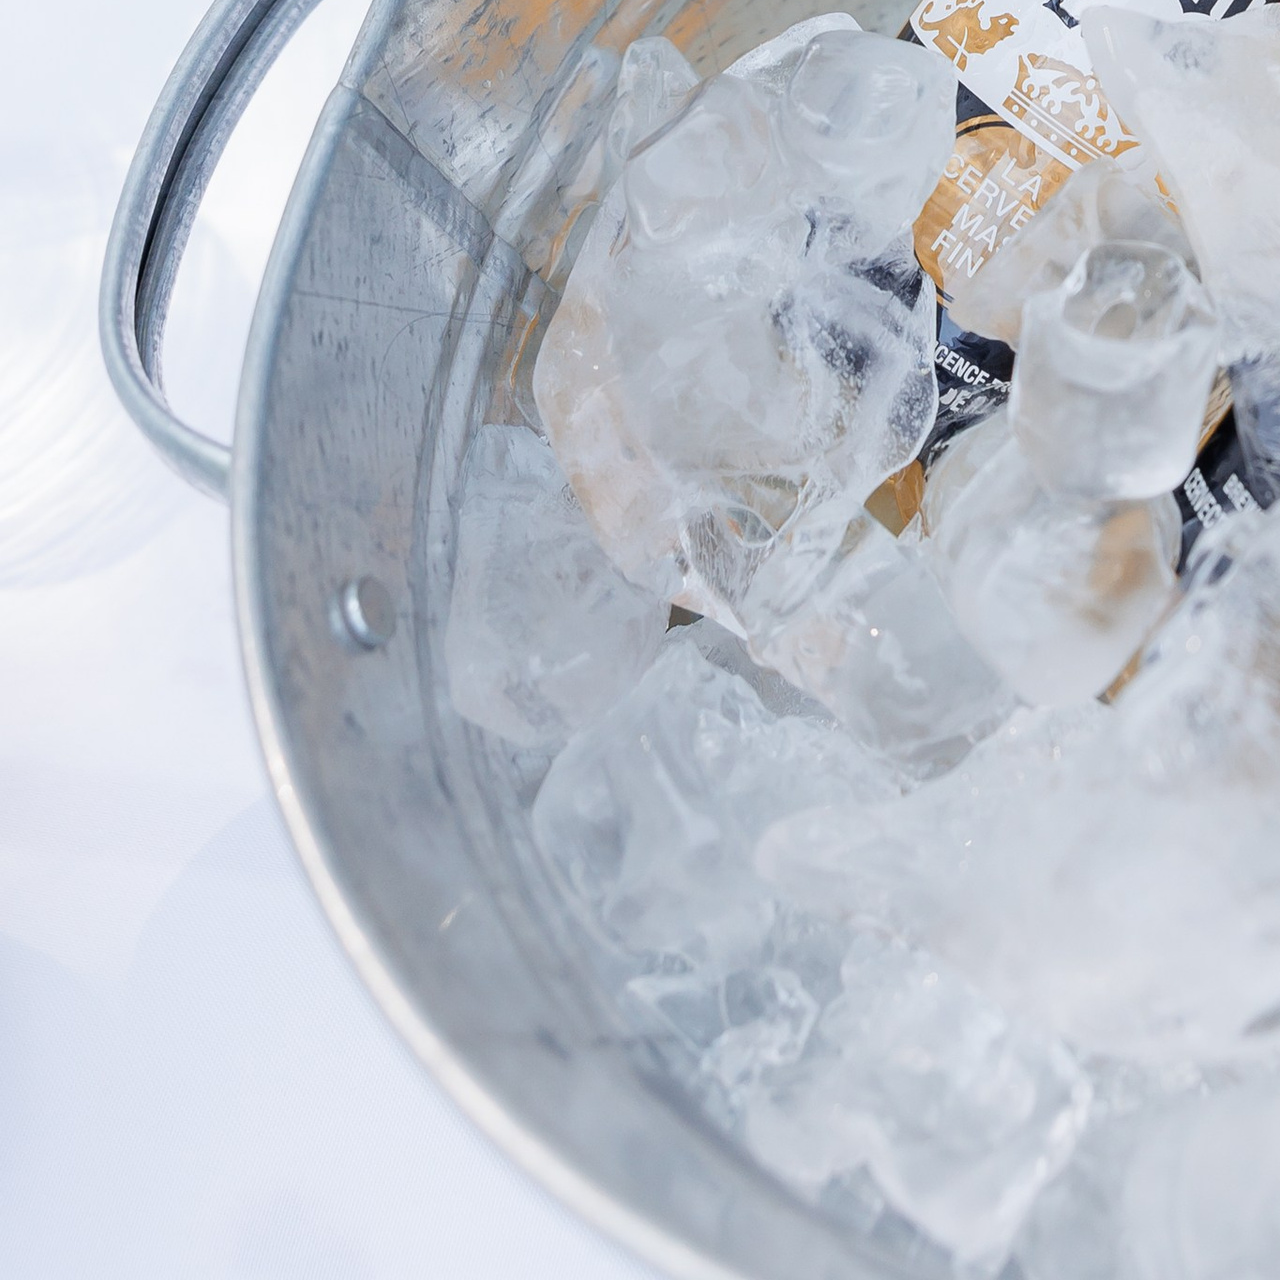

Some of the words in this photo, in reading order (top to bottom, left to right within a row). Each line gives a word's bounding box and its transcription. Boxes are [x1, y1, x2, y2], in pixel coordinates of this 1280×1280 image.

[943, 153, 1036, 231] CERVE
[1001, 157, 1043, 202] LA
[951, 202, 1012, 253] MA
[930, 228, 984, 279] FIN
